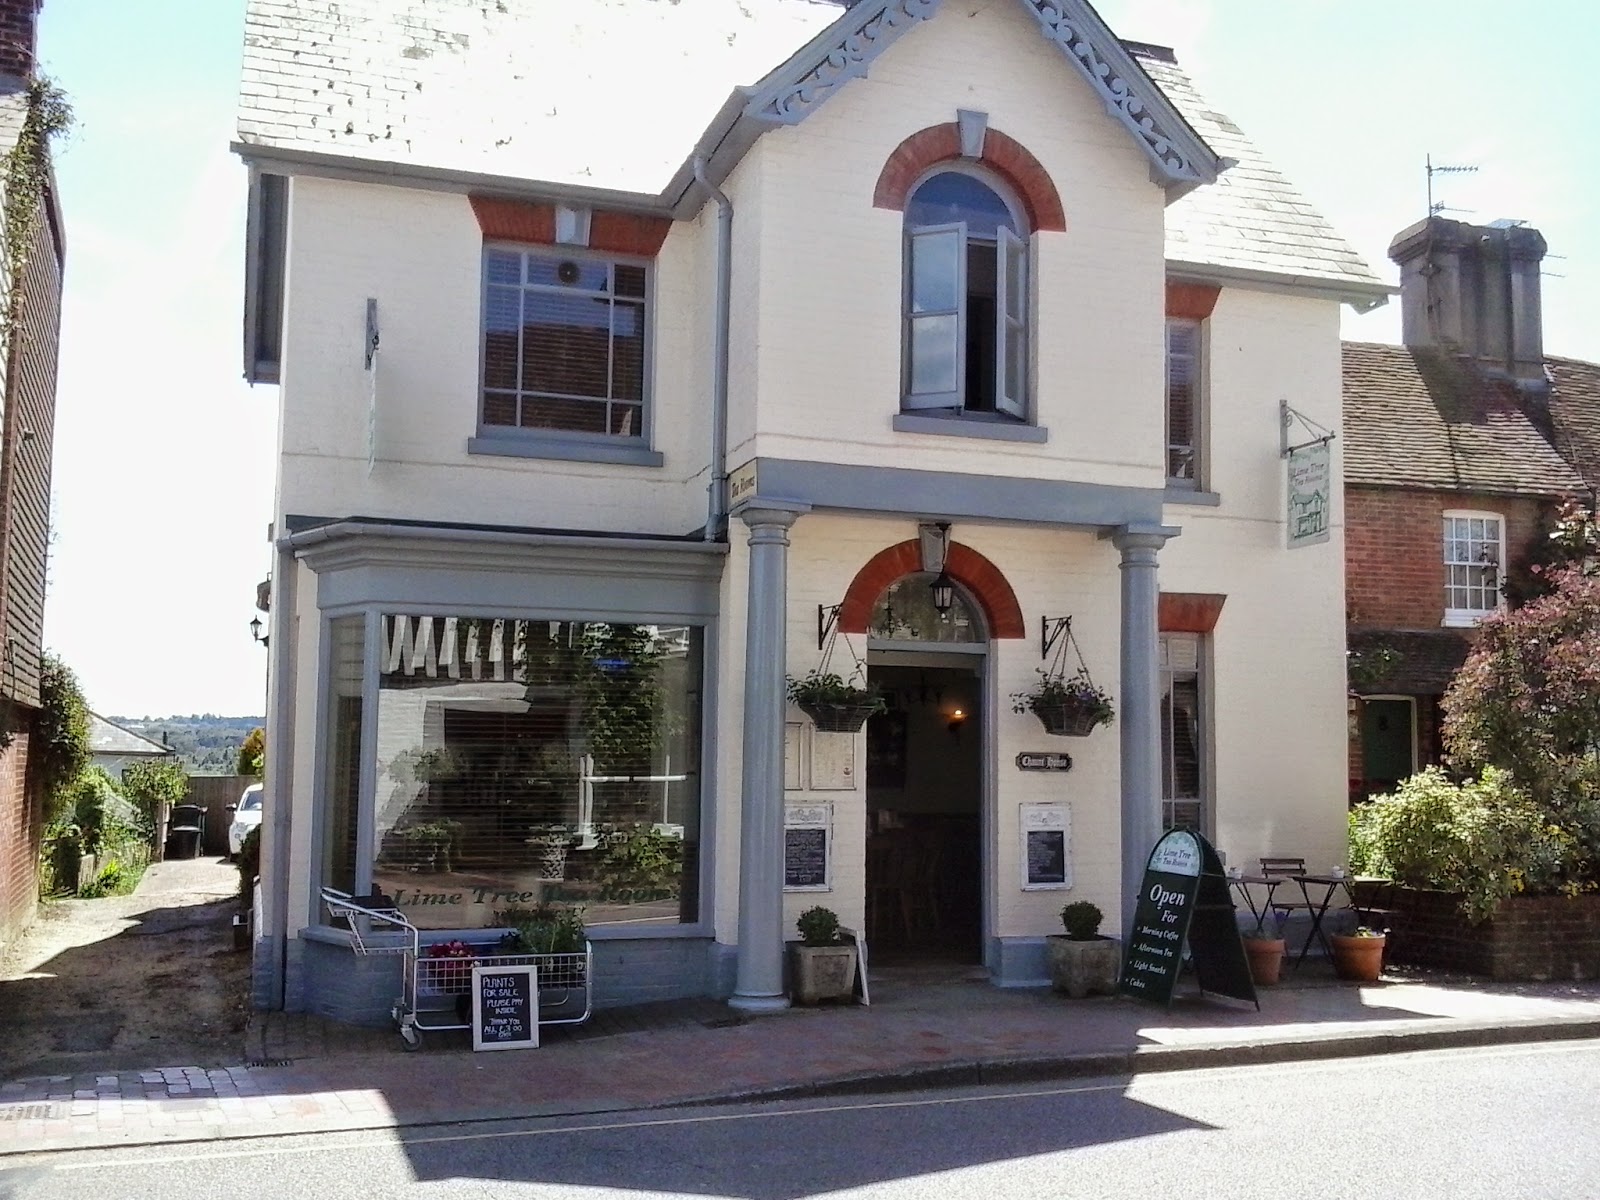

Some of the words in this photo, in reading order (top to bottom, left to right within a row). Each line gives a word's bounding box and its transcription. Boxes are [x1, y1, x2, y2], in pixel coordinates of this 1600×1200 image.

[1163, 848, 1177, 858] Lime
[1177, 849, 1192, 859] Tree
[393, 888, 463, 906] Lime
[472, 886, 533, 905] Tree
[1150, 883, 1185, 910] Open
[1161, 909, 1179, 924] For
[1142, 925, 1163, 939] Morning
[1163, 929, 1180, 941] Coffee
[1137, 942, 1164, 956] Afternoon
[1163, 947, 1174, 958] Tea
[1134, 959, 1148, 972] Light
[1148, 963, 1167, 975] Snacks
[482, 976, 515, 988] PLANTS
[1129, 977, 1146, 989] Cakes
[483, 989, 497, 998] FOR
[498, 988, 519, 997] SALE
[484, 1026, 498, 1035] ALL
